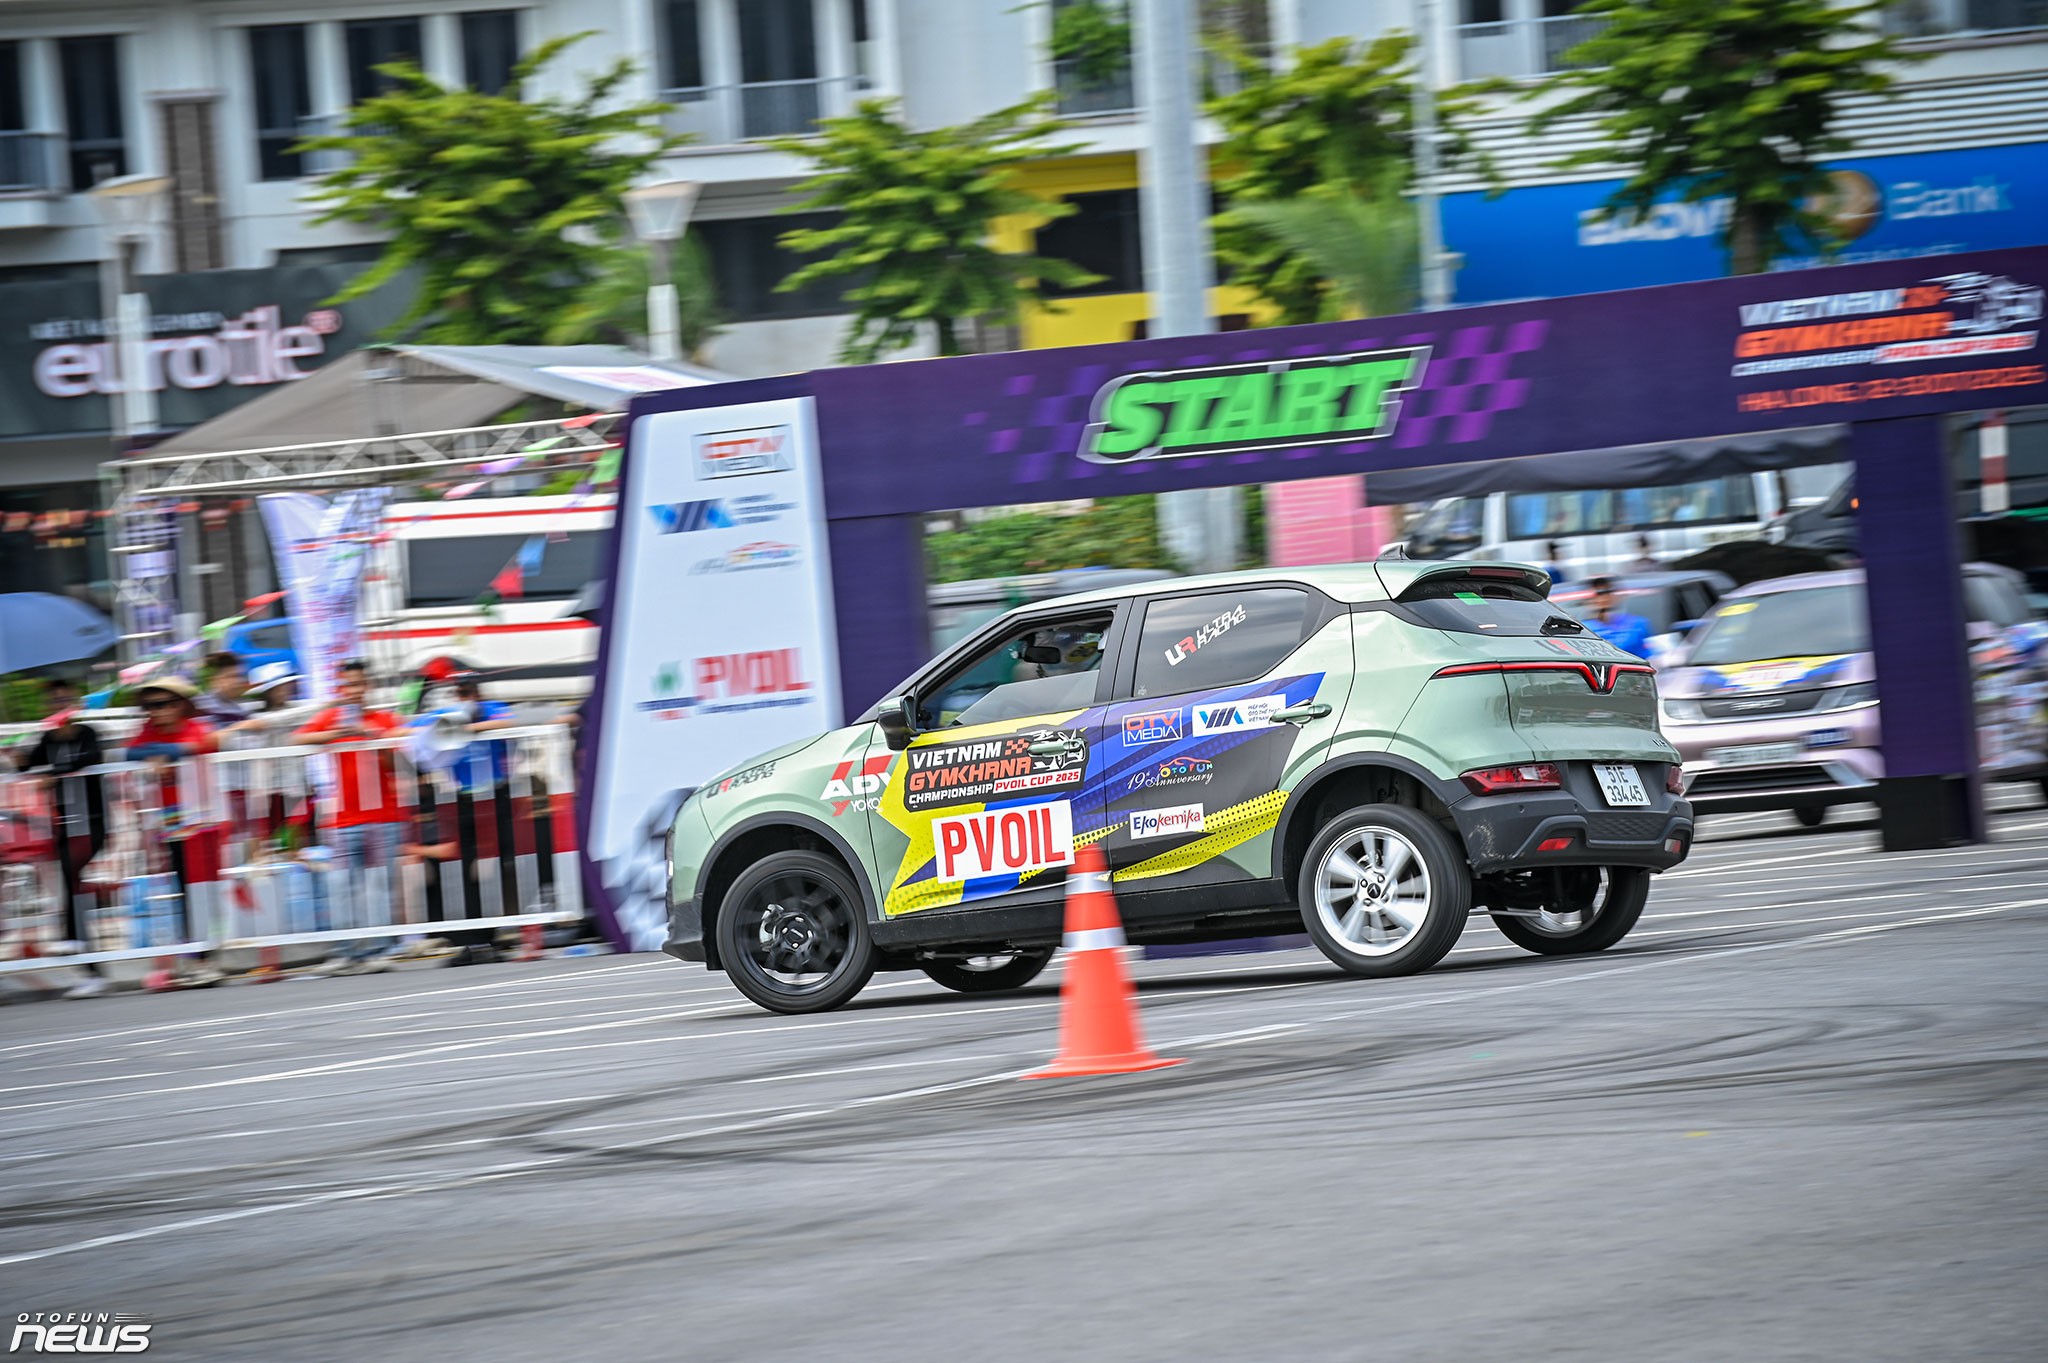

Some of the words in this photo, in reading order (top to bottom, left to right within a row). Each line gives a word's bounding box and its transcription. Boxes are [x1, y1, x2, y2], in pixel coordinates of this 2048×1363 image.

[1092, 358, 1419, 454] START
[1164, 636, 1197, 666] UR
[1196, 604, 1246, 638] ULTRA
[1196, 614, 1247, 649] RACING
[1126, 712, 1179, 731] OTV
[1127, 725, 1181, 742] MEDIA
[912, 741, 1003, 769] VIETNAM
[908, 783, 994, 804] CHAMPIONSHIP
[995, 778, 1028, 791] PVOIL
[1030, 775, 1053, 786] CUP
[1056, 771, 1080, 783] 2025
[909, 756, 1032, 791] GYMKHANA
[1145, 773, 1213, 788] Anniversary
[1605, 766, 1629, 783] 51E
[1607, 785, 1644, 803] 334.45
[1133, 809, 1201, 835] Ekokemika
[941, 807, 1066, 878] PVOIL
